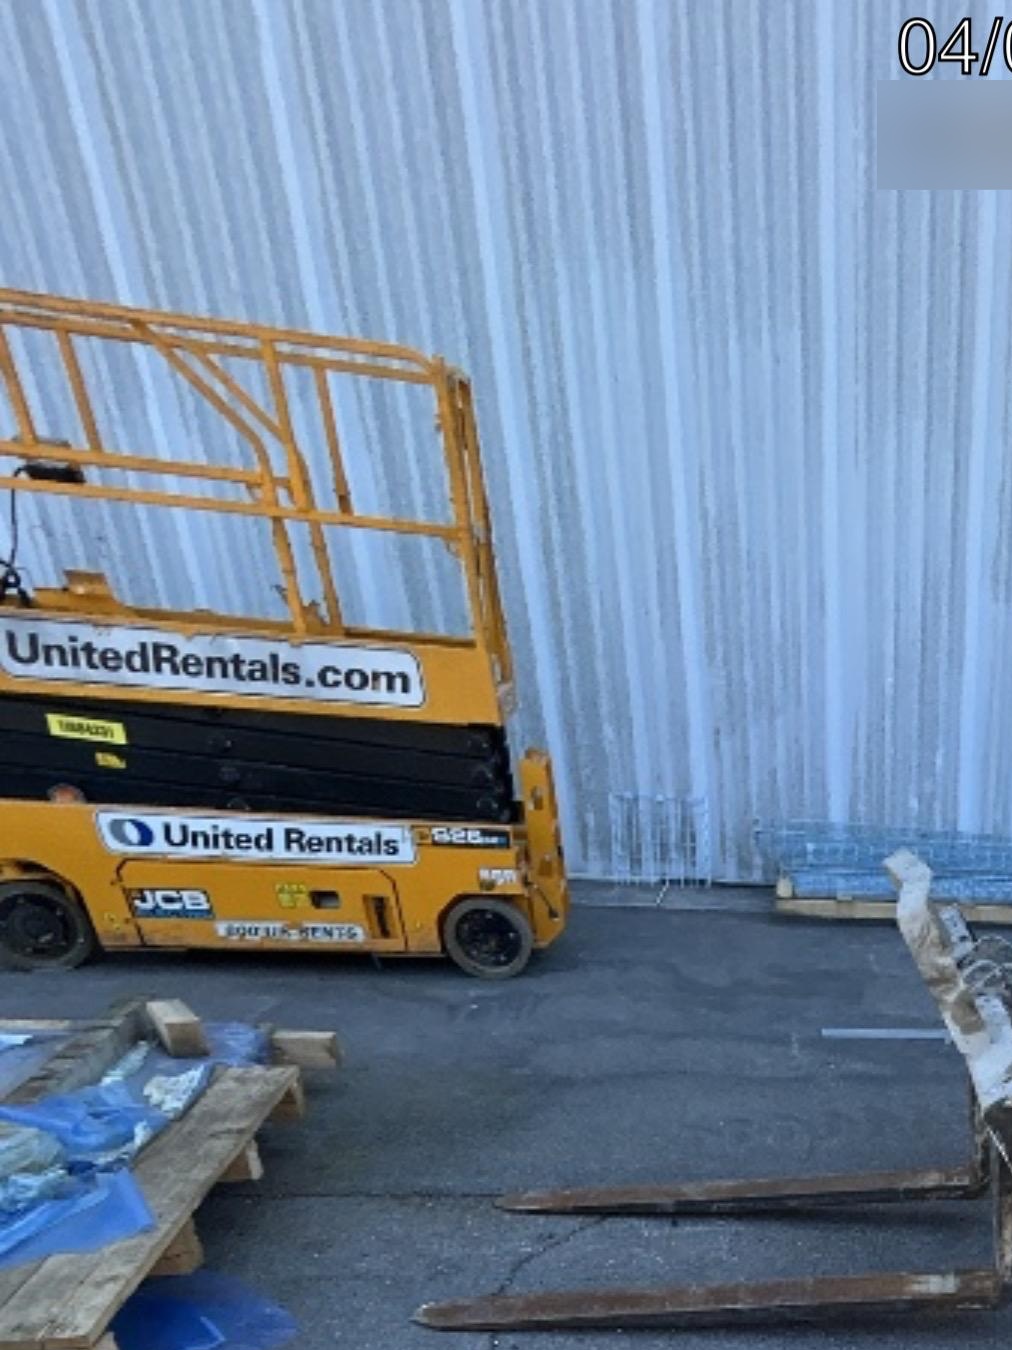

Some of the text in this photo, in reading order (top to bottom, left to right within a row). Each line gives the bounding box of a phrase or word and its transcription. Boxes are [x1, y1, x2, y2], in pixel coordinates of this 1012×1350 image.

[5, 630, 411, 694] UnitedRentals.com
[163, 822, 400, 856] United Rentals
[134, 889, 211, 911] JCB
